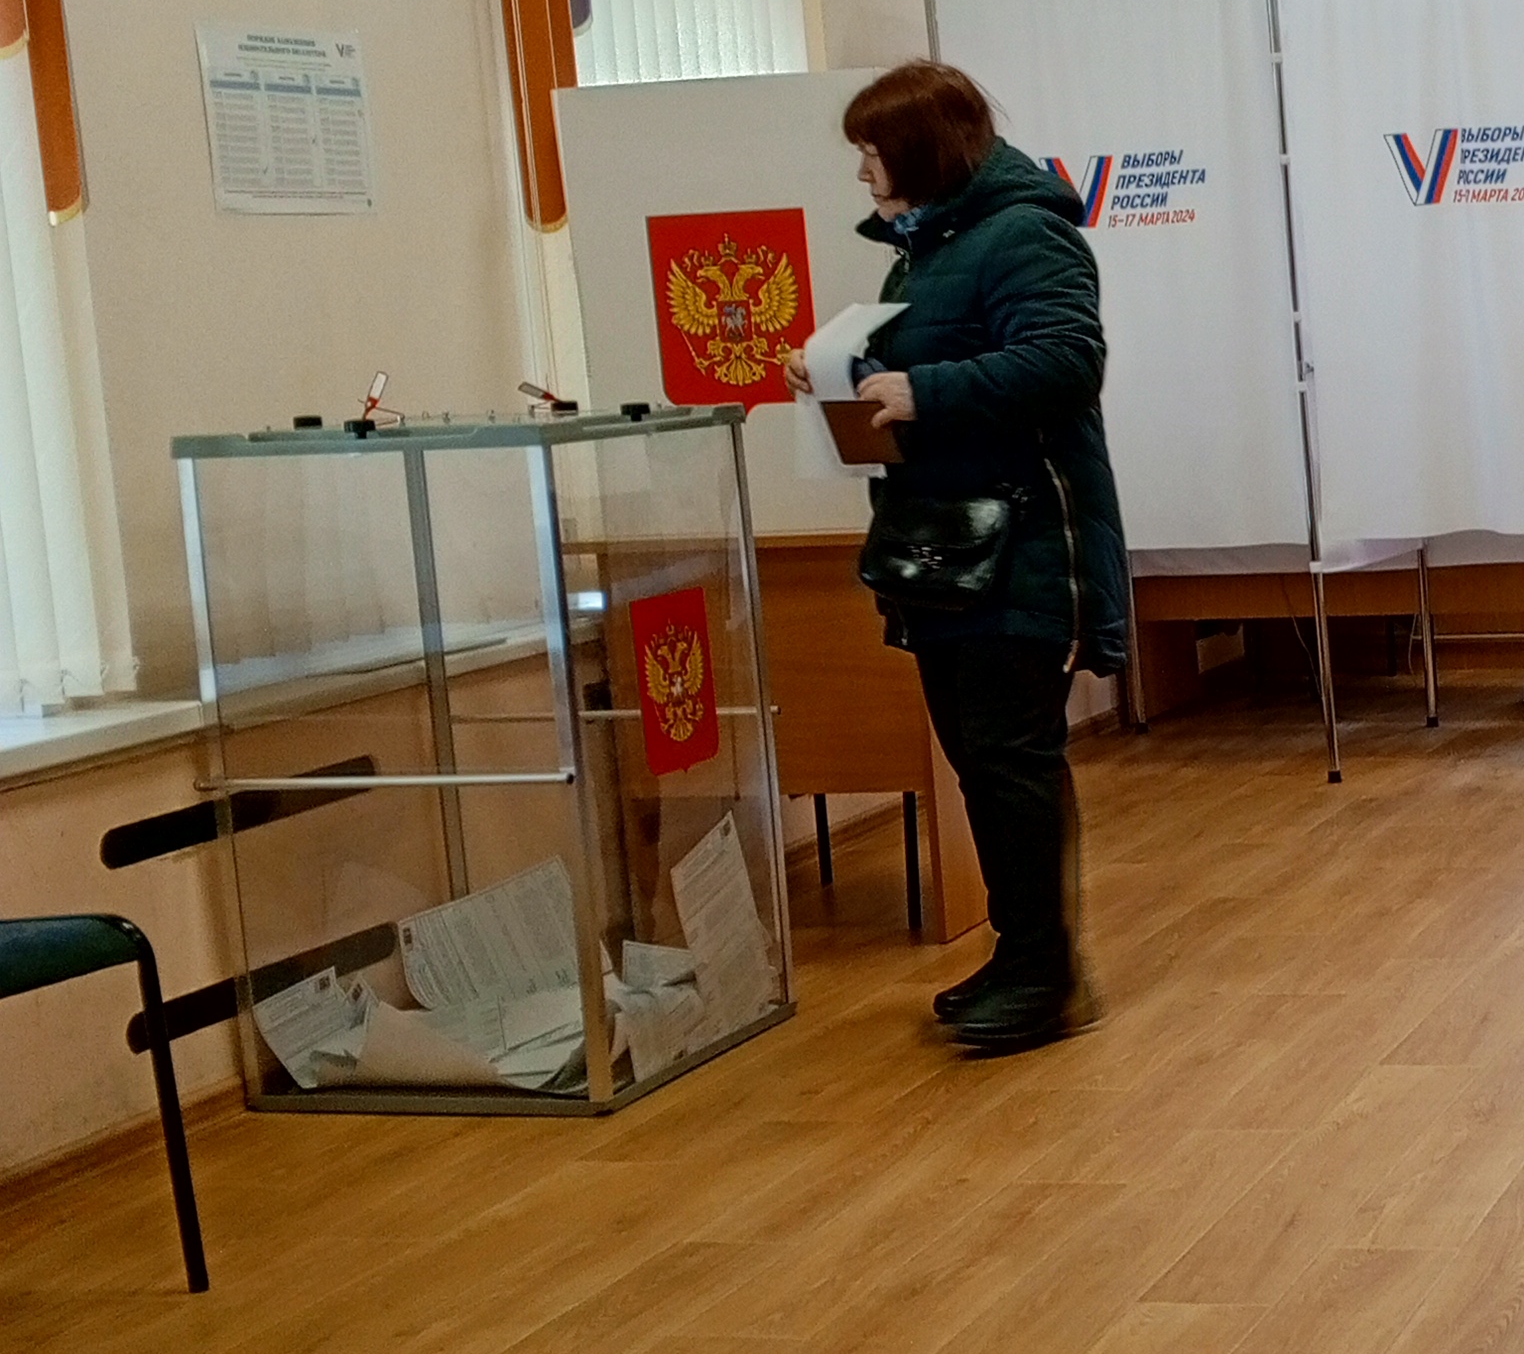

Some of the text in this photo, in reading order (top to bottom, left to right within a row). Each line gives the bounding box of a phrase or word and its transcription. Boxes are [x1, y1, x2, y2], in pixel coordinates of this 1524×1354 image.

[1120, 149, 1184, 170] ВЫБОРЫ
[1115, 168, 1207, 190] ПРЕЗИДЕНТА
[1111, 191, 1169, 210] РОССИИ
[1471, 188, 1509, 203] МАРТА
[1137, 211, 1172, 227] МАРТА
[1172, 209, 1196, 225] 2024
